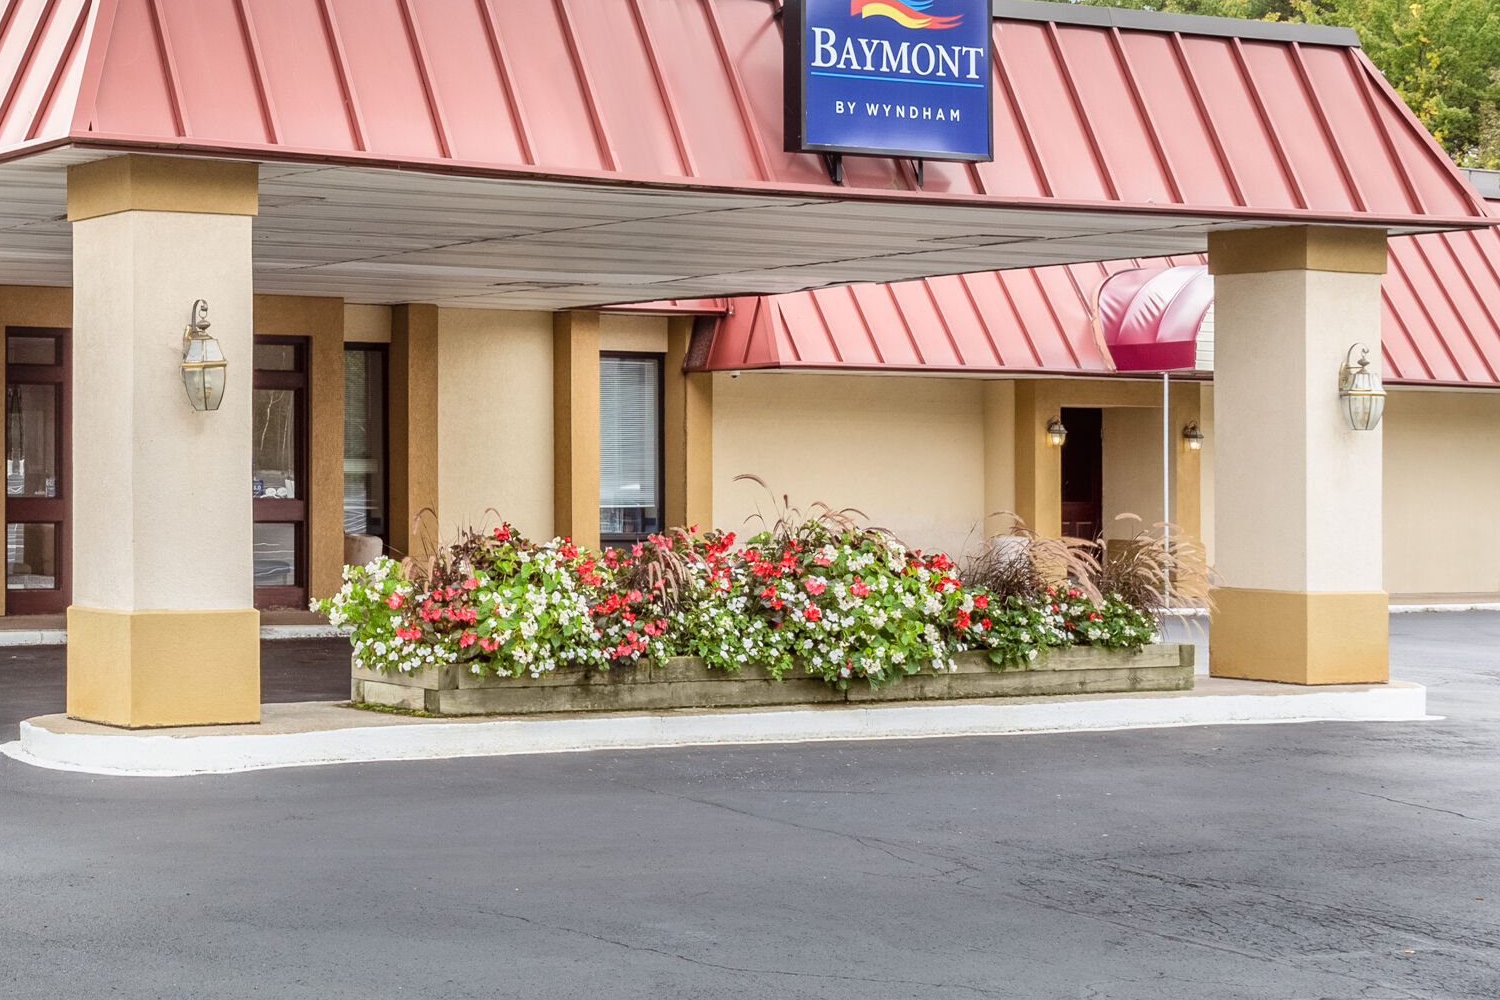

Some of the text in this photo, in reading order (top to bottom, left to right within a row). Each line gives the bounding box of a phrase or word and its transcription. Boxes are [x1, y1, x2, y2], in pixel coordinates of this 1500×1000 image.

[811, 26, 984, 79] BAYMONT
[835, 100, 960, 122] BY WYNDHAM
